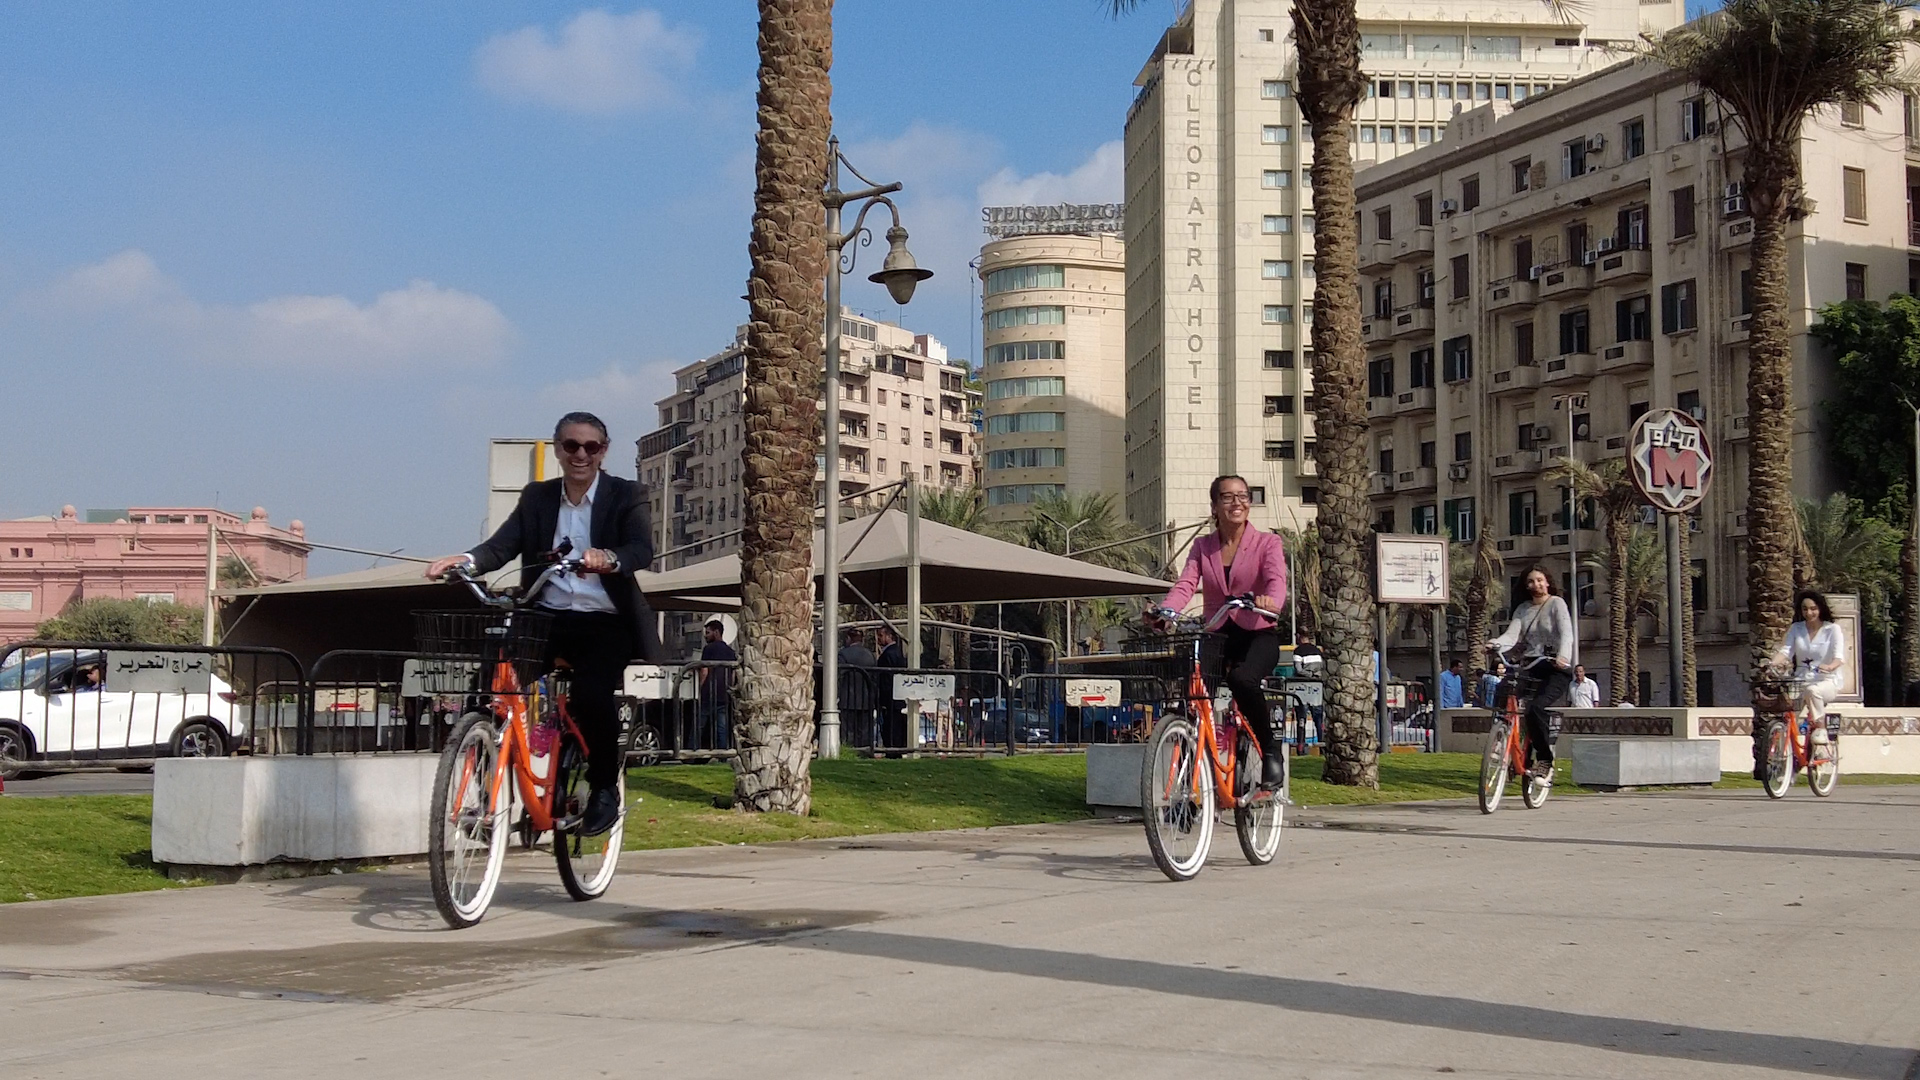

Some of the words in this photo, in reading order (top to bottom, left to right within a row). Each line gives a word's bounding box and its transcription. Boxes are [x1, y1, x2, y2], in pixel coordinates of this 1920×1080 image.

[1186, 69, 1205, 293] CLEOPATRA
[1186, 308, 1204, 431] HOTEL
[1651, 447, 1697, 490] M
[115, 654, 169, 674] التحرير
[901, 675, 928, 688] التحرير
